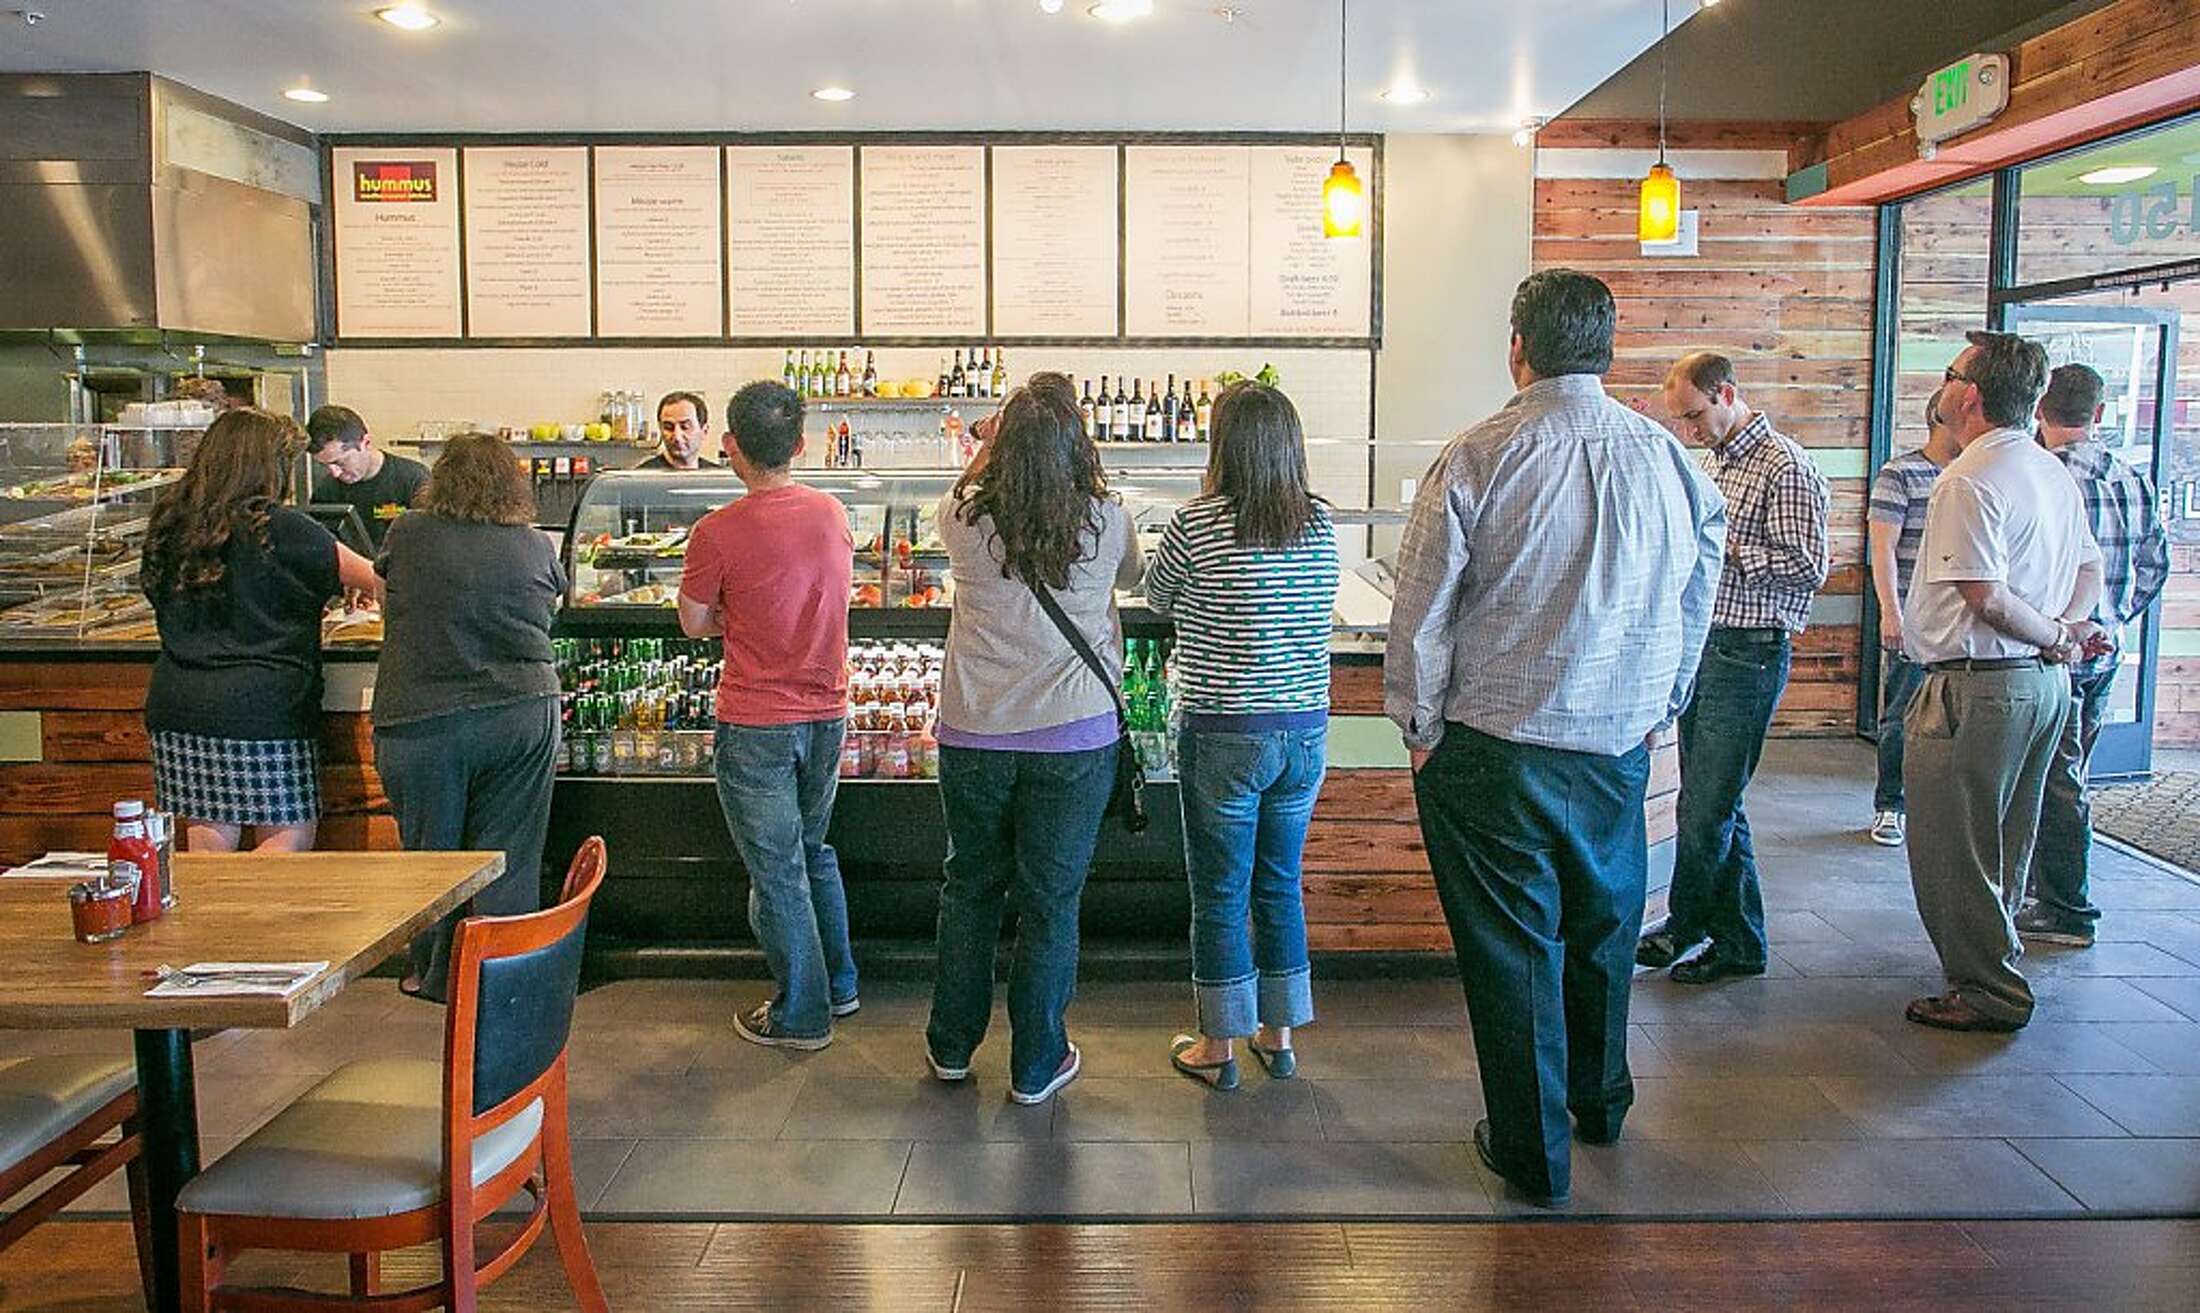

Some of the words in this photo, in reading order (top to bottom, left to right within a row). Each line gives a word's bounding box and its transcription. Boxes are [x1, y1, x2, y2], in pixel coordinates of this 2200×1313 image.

[1934, 62, 1969, 116] EXIT
[360, 173, 432, 192] hummus
[375, 212, 416, 223] Hummus
